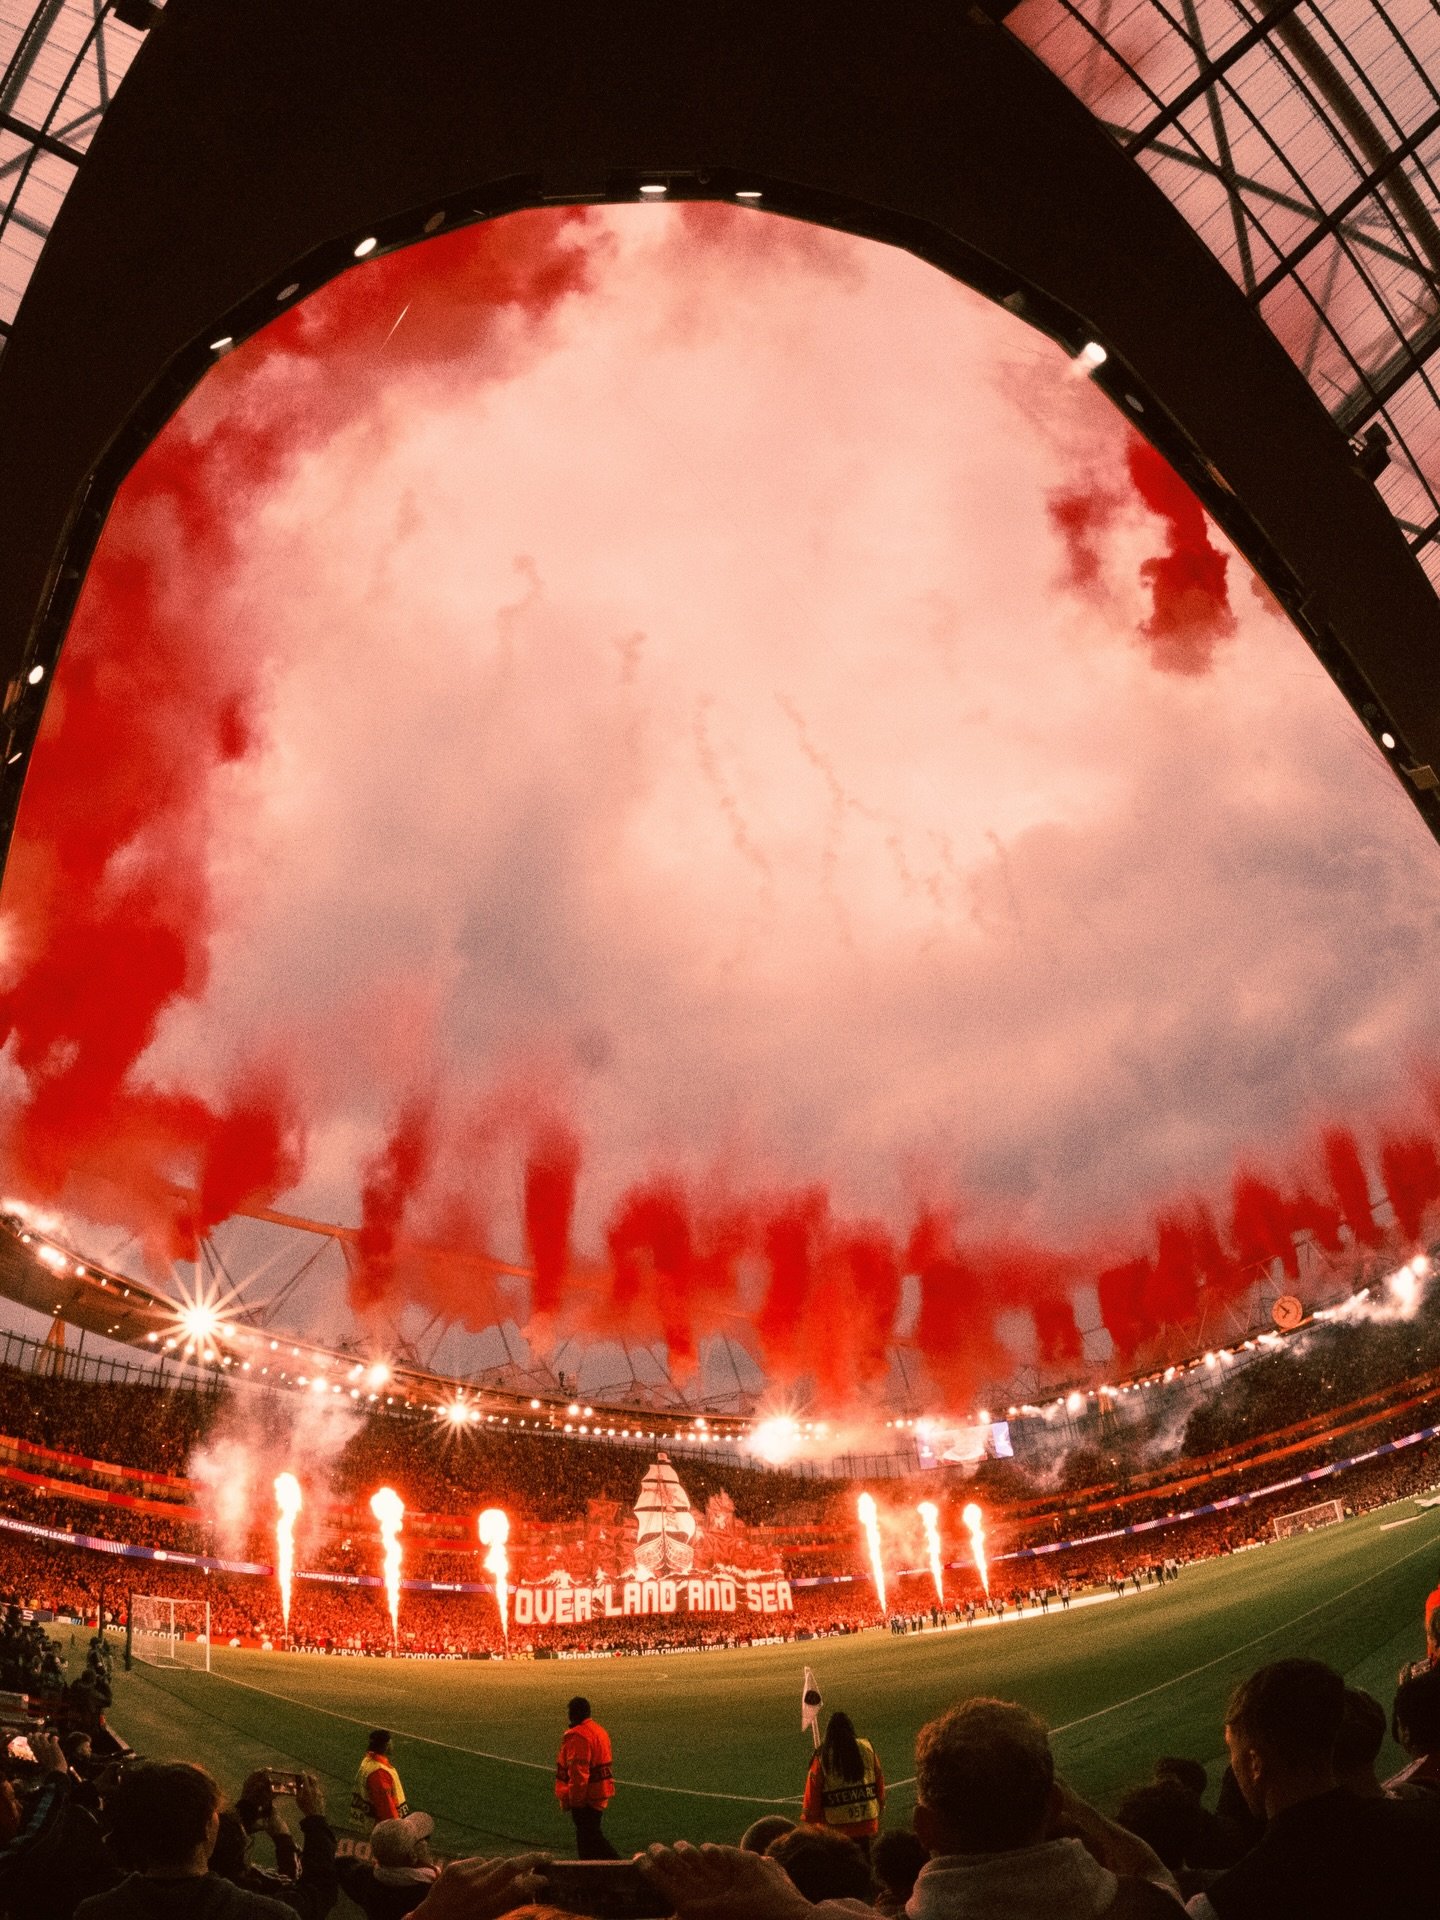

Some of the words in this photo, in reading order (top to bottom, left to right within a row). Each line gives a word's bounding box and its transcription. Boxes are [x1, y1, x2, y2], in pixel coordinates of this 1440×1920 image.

[8, 1521, 49, 1537] CHAMPIONS
[49, 1530, 76, 1543] LEAGUE
[296, 1571, 334, 1582] CHAMPIONS
[515, 1588, 592, 1624] OVER
[605, 1581, 676, 1616] LAND
[688, 1580, 736, 1611] AND
[747, 1581, 793, 1612] SEA
[106, 1624, 180, 1640] matercard
[752, 1636, 784, 1647] PEPSI
[400, 1651, 463, 1661] cryptocom
[557, 1650, 612, 1660] Heineken
[641, 1648, 660, 1657] UEFA
[661, 1644, 700, 1656] CHAMPIONS
[701, 1643, 726, 1652] LEAGUE
